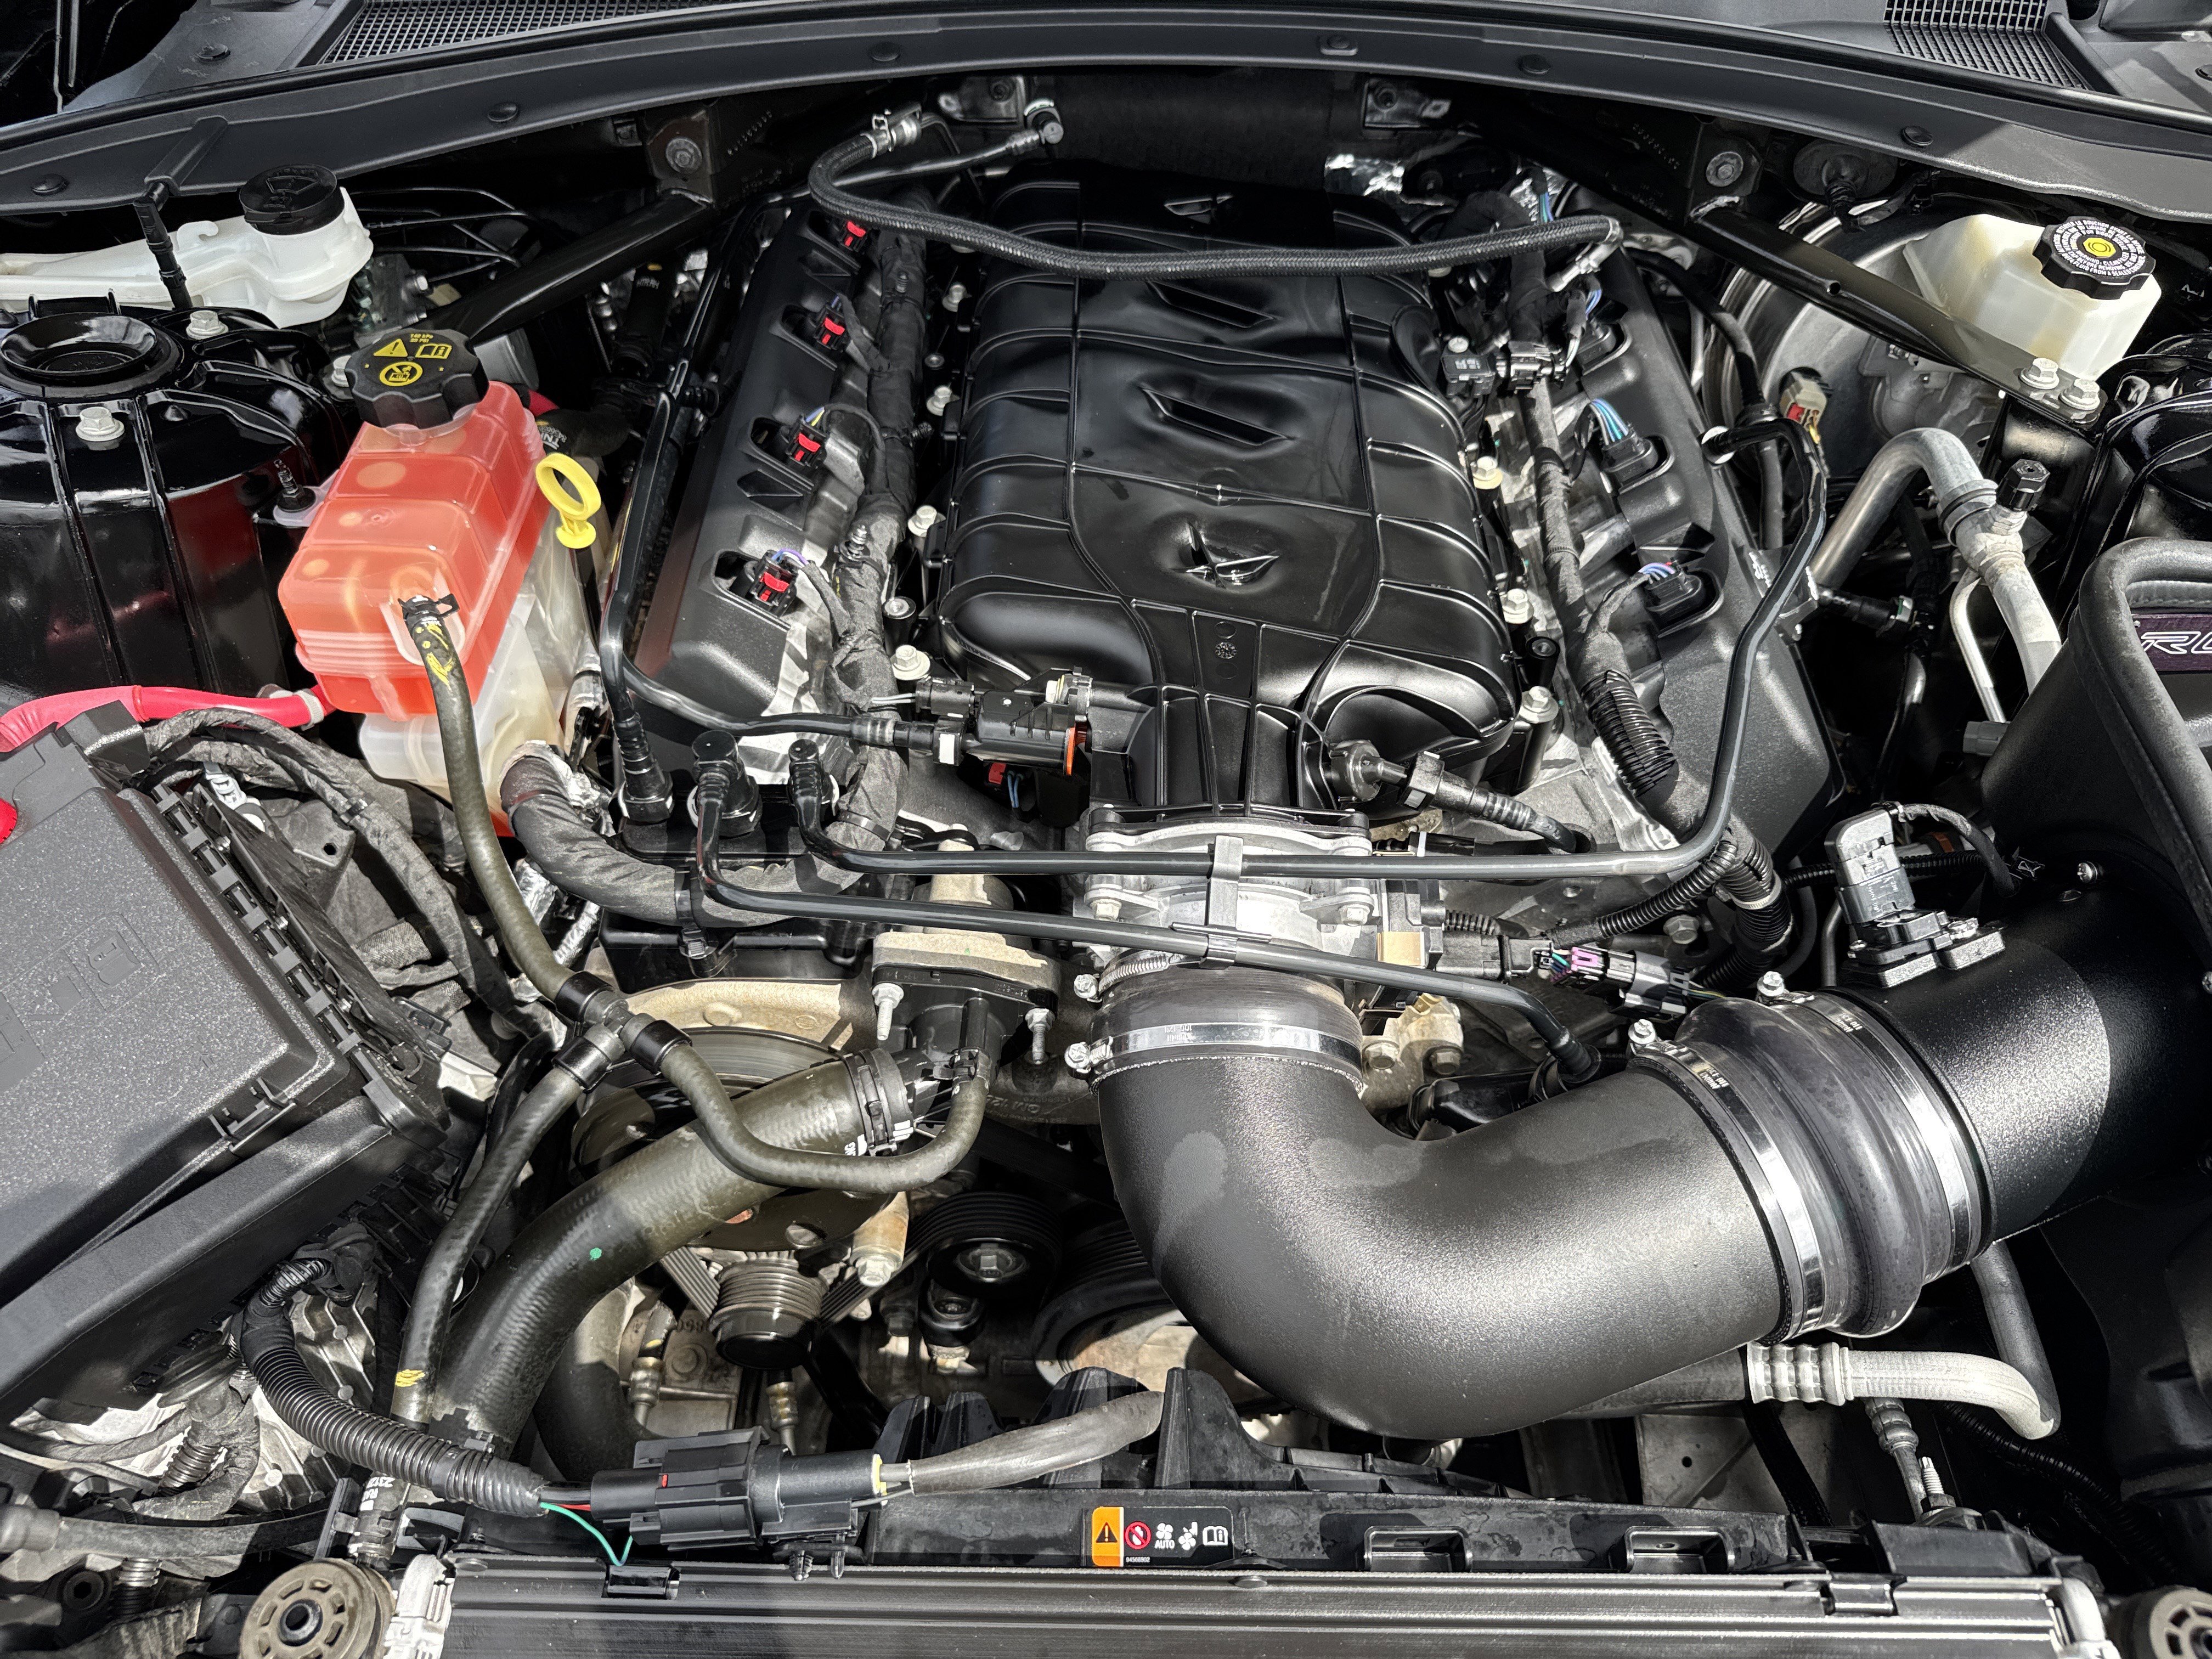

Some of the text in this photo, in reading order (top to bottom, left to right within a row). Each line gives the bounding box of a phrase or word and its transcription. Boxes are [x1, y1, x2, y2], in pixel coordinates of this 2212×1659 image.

[2082, 219, 2109, 228] BOUCHON
[2109, 225, 2128, 236] AVANT
[2072, 261, 2090, 271] FLUID
[2089, 267, 2107, 276] FROM
[2075, 257, 2098, 269] BEFORE
[1154, 1539, 1175, 1549] AUTO
